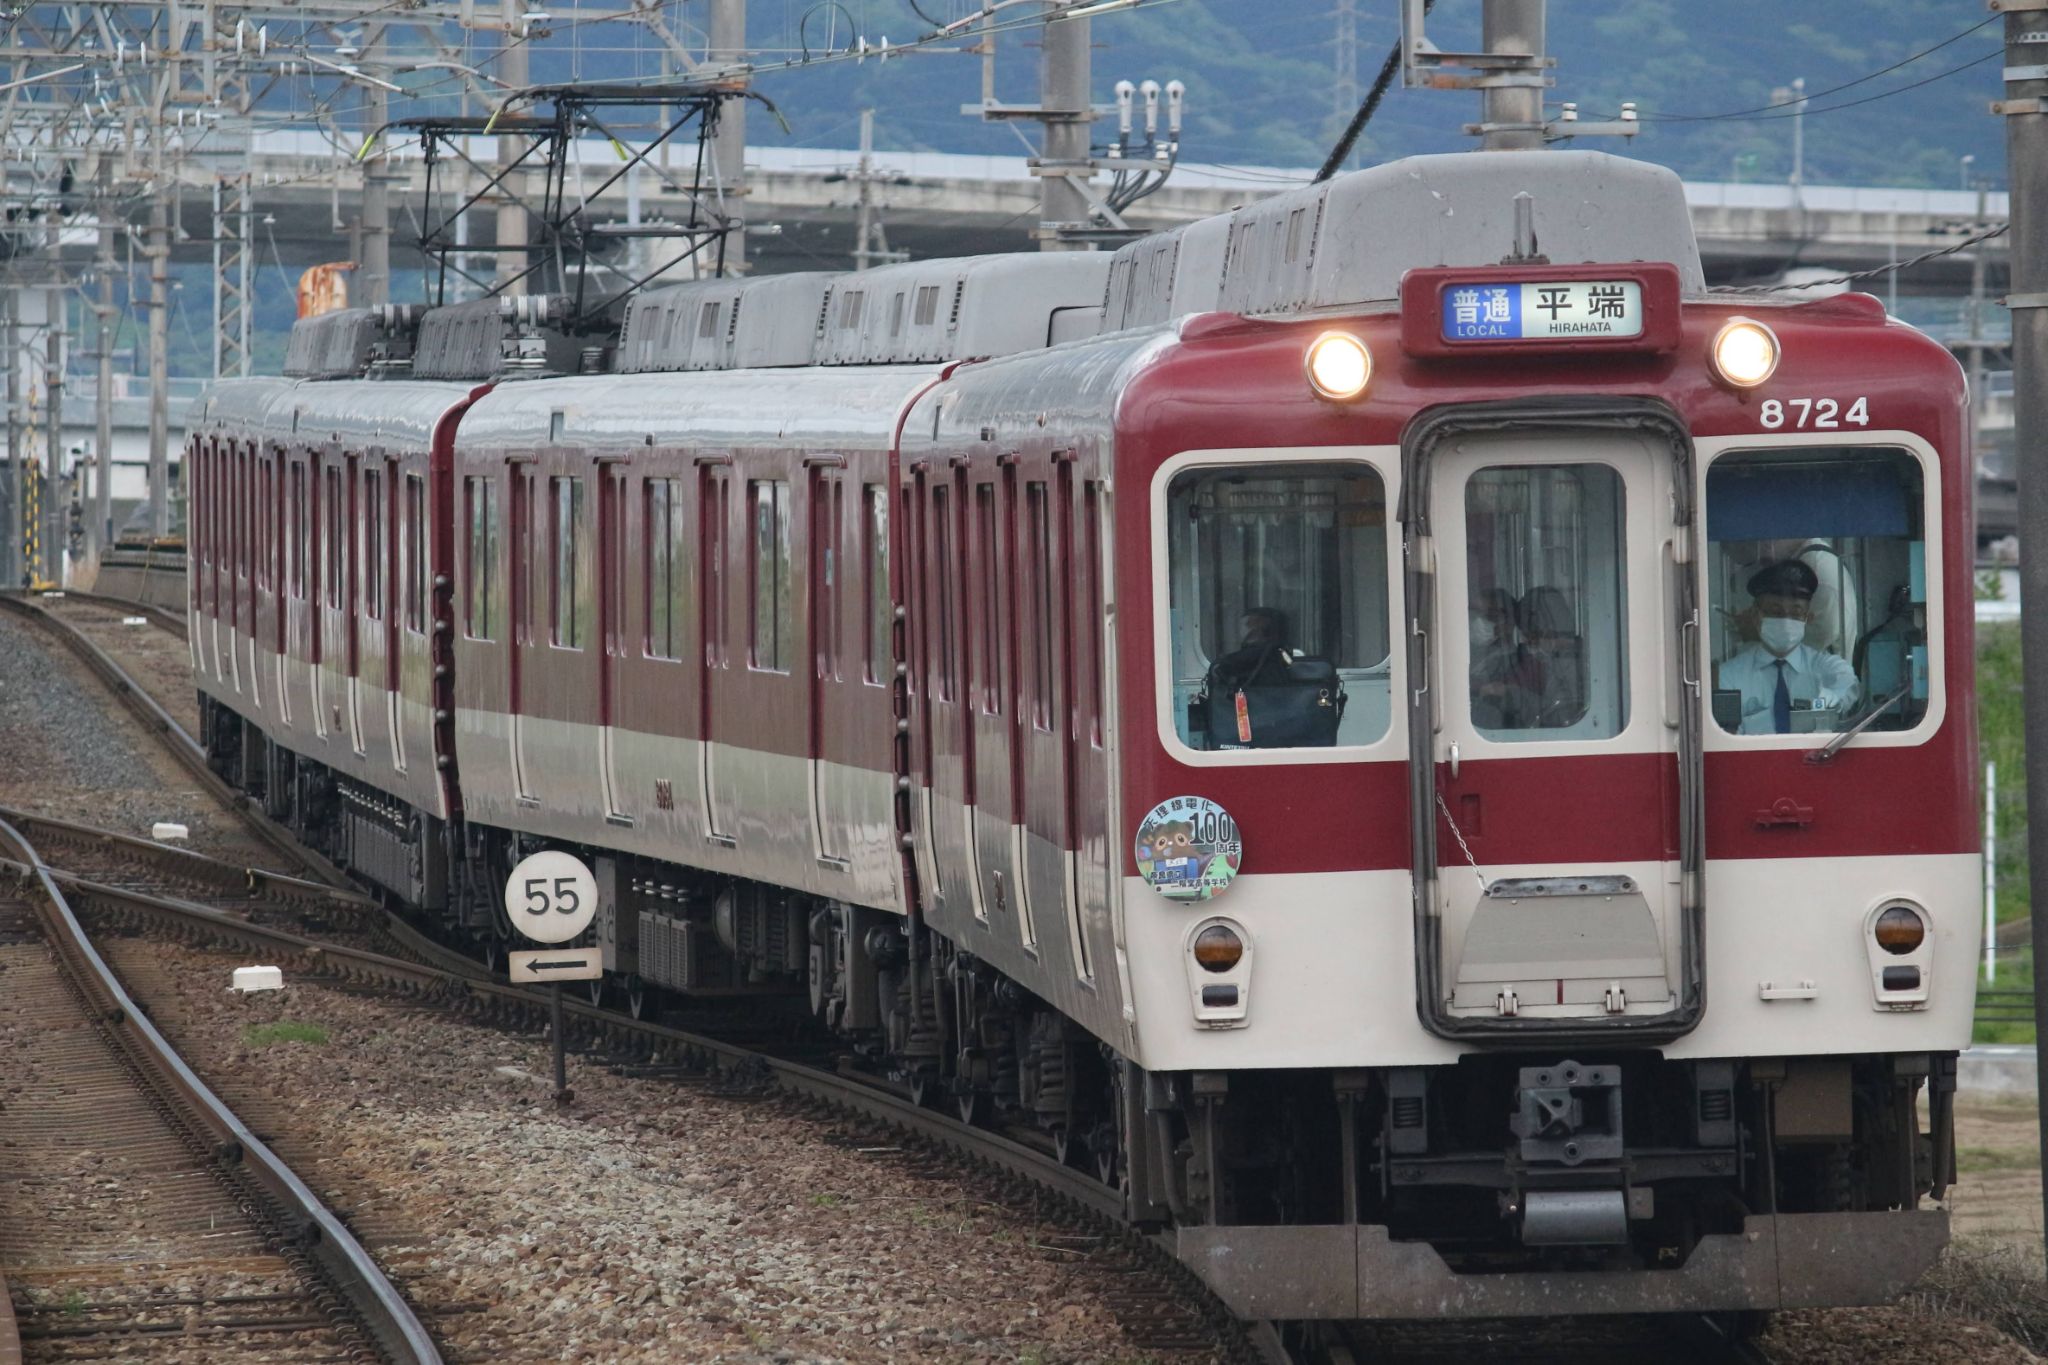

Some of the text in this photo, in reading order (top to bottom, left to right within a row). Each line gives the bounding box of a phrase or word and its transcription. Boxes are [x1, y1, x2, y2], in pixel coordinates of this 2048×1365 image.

[1451, 285, 1625, 324] 普通 平端
[1457, 325, 1507, 336] LOCAL
[1549, 322, 1612, 333] HIRAHATA
[1760, 397, 1870, 428] 8724
[1189, 812, 1231, 844] 100
[1216, 843, 1239, 854] 周年
[525, 877, 580, 915] 55
